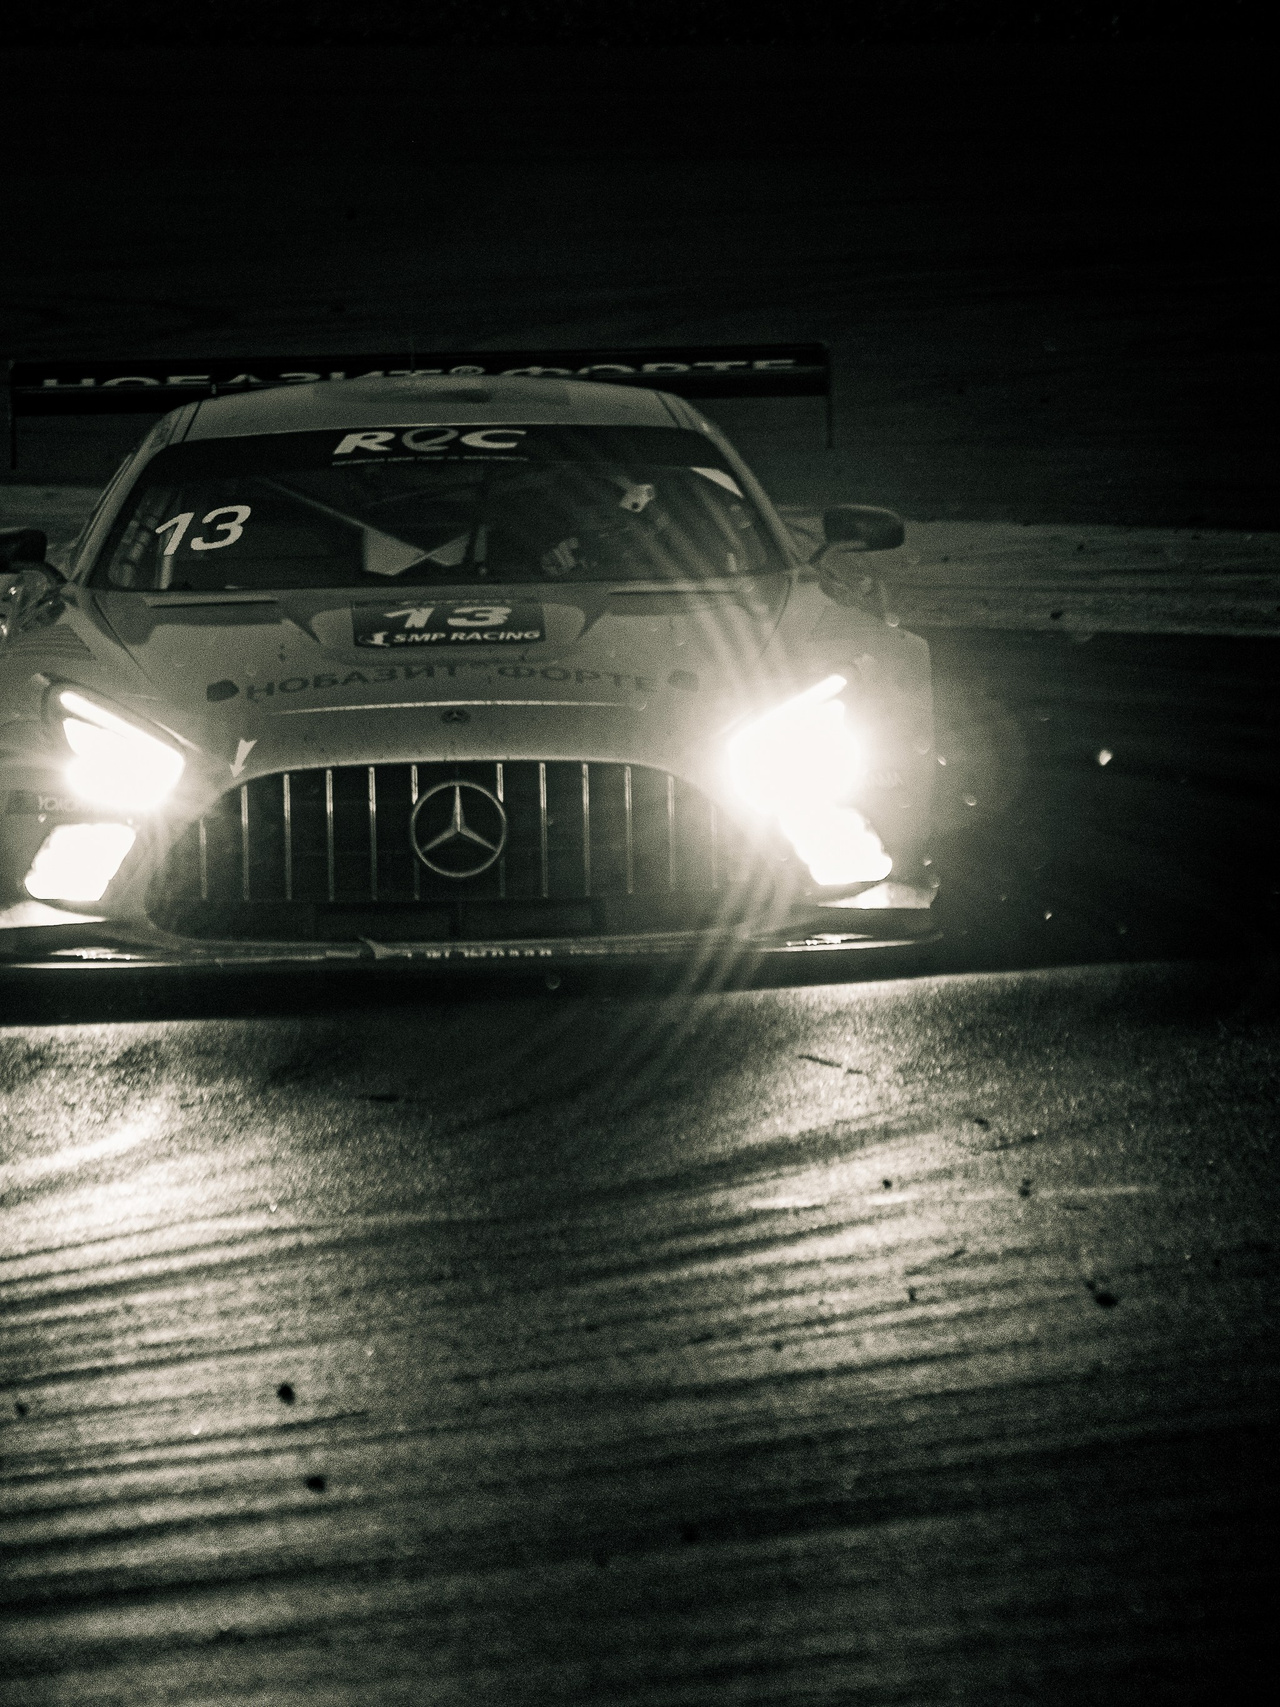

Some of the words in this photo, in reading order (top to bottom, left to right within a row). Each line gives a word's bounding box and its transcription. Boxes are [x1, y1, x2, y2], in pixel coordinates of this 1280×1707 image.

[155, 505, 251, 556] 13
[383, 606, 512, 628] 13
[393, 632, 446, 643] SMP
[450, 630, 541, 642] RACING
[498, 665, 658, 692] ФОРТЕ
